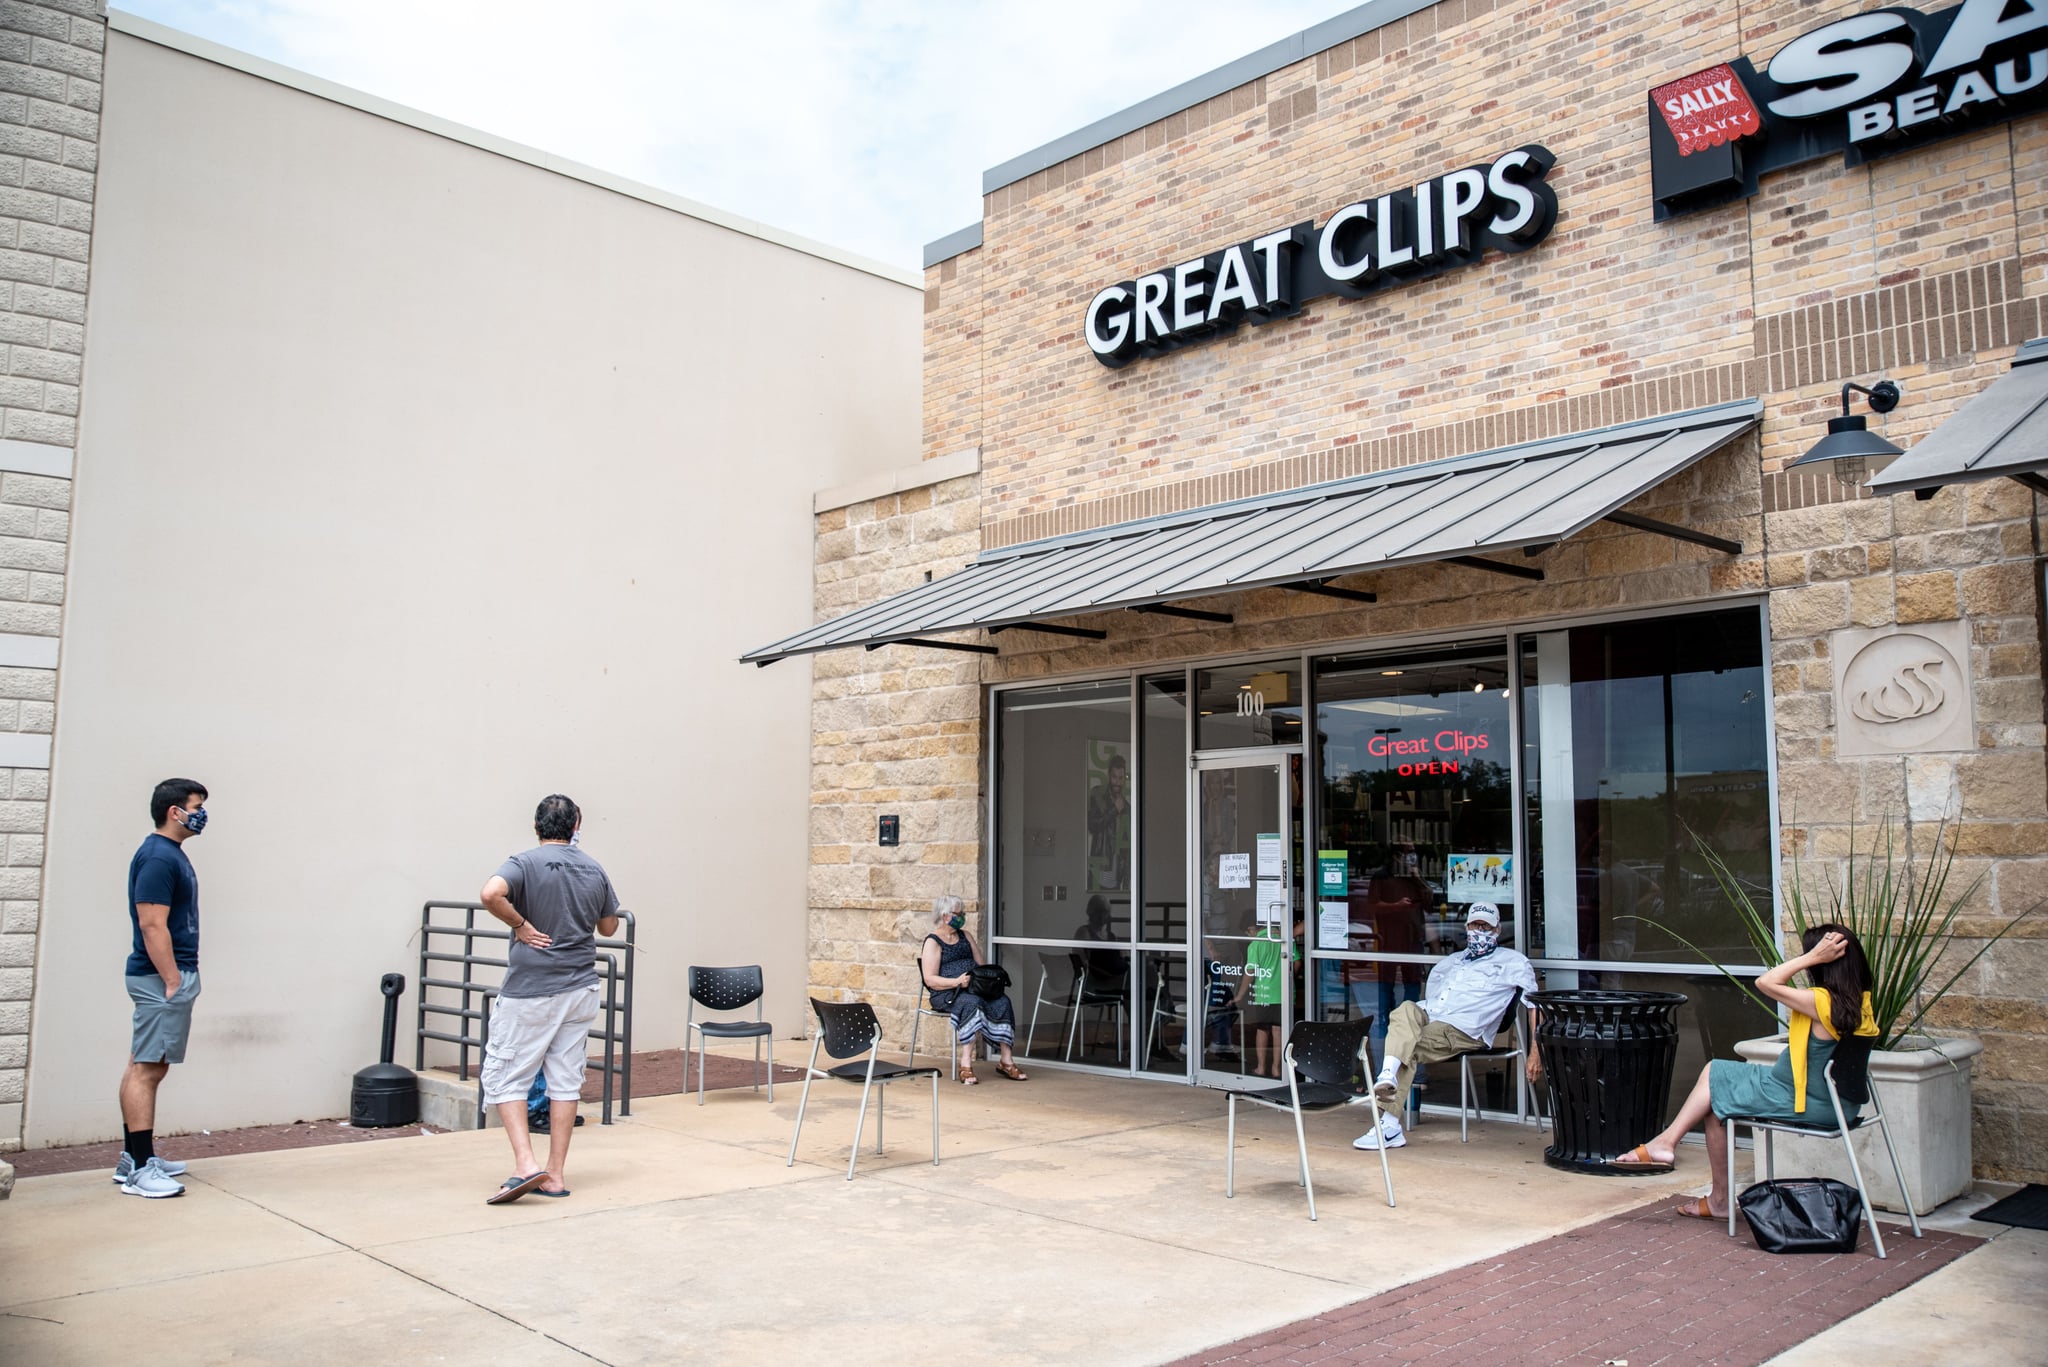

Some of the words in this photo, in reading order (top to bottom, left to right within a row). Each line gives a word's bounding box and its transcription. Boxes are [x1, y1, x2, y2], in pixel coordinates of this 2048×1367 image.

[1767, 0, 2048, 118] SA
[1664, 79, 1738, 121] SALLY
[1848, 48, 2048, 143] BEAU
[1678, 110, 1753, 143] BEAUTY
[1084, 228, 1292, 354] GREAT
[1318, 150, 1535, 281] CLIPS
[1236, 691, 1264, 717] 100
[1367, 736, 1429, 757] Great
[1434, 730, 1489, 756] Clips
[1398, 760, 1459, 777] OPEN
[1210, 961, 1242, 976] Great
[1244, 962, 1272, 981] Clips
